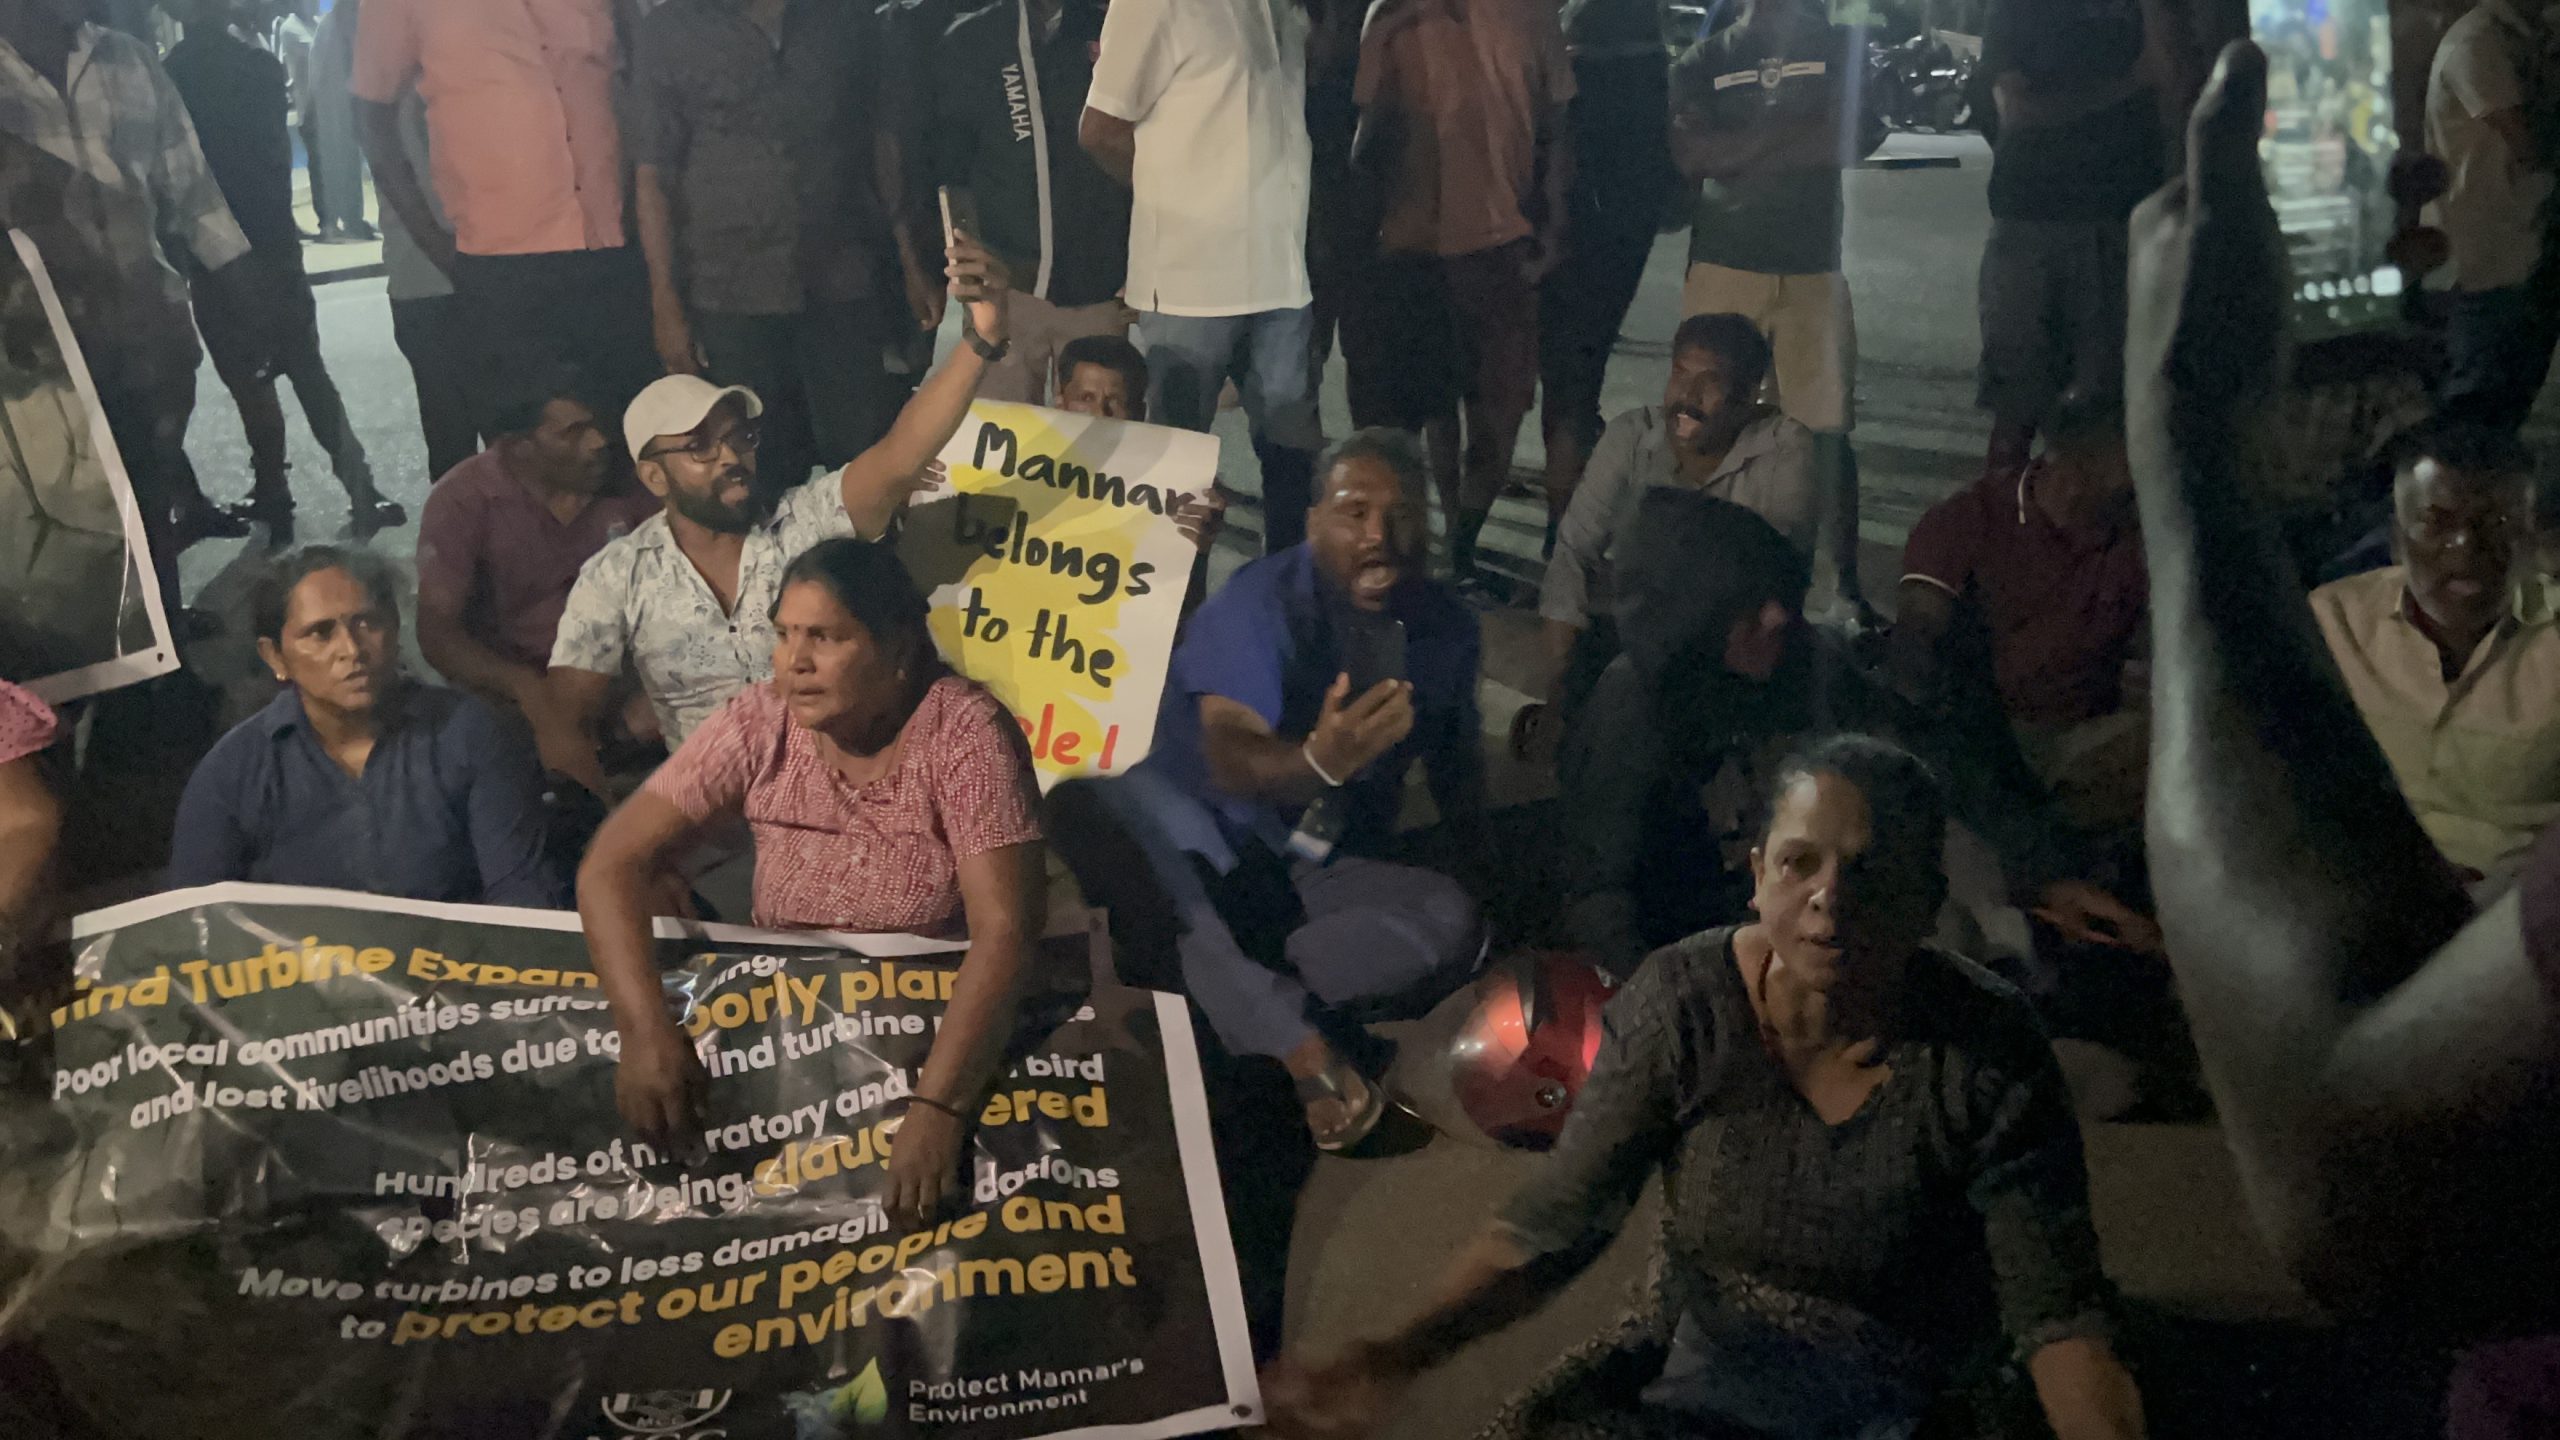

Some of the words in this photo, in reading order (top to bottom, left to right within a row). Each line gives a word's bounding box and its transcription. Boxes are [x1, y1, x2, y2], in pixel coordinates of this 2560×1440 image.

[1001, 63, 1032, 142] YAMAHA
[973, 422, 1197, 517] Mannar
[955, 491, 1156, 604] belongs
[960, 587, 1008, 643] to
[1026, 608, 1115, 688] the
[51, 965, 170, 1029] ind
[179, 935, 396, 1005] Turbine
[406, 947, 600, 989] Expan
[53, 1054, 123, 1100] Poor
[126, 1039, 229, 1075] local
[237, 999, 481, 1066] communities
[130, 1081, 195, 1129] and
[202, 1081, 288, 1109] lost
[296, 1050, 495, 1111] livelihoods
[501, 1036, 577, 1074] due
[584, 1027, 622, 1056] to
[782, 1010, 925, 1060] turbine
[375, 1152, 578, 1198] Hundreds
[586, 1138, 624, 1176] of
[835, 1068, 908, 1118] and
[1025, 1053, 1105, 1082] bird
[550, 1195, 619, 1226] are
[625, 1173, 745, 1220] being
[238, 1266, 364, 1300] Move
[375, 1273, 559, 1304] turbines
[568, 1265, 612, 1290] to
[620, 1250, 703, 1284] less
[340, 1314, 387, 1339] to
[391, 1291, 645, 1346] protect
[657, 1271, 767, 1319] our
[778, 1210, 988, 1309] people
[1001, 1194, 1126, 1235] and
[713, 1246, 1138, 1359] environment
[908, 1372, 1010, 1401] Protect
[1019, 1356, 1145, 1391] Mannar's
[908, 1389, 1089, 1423] Environment
